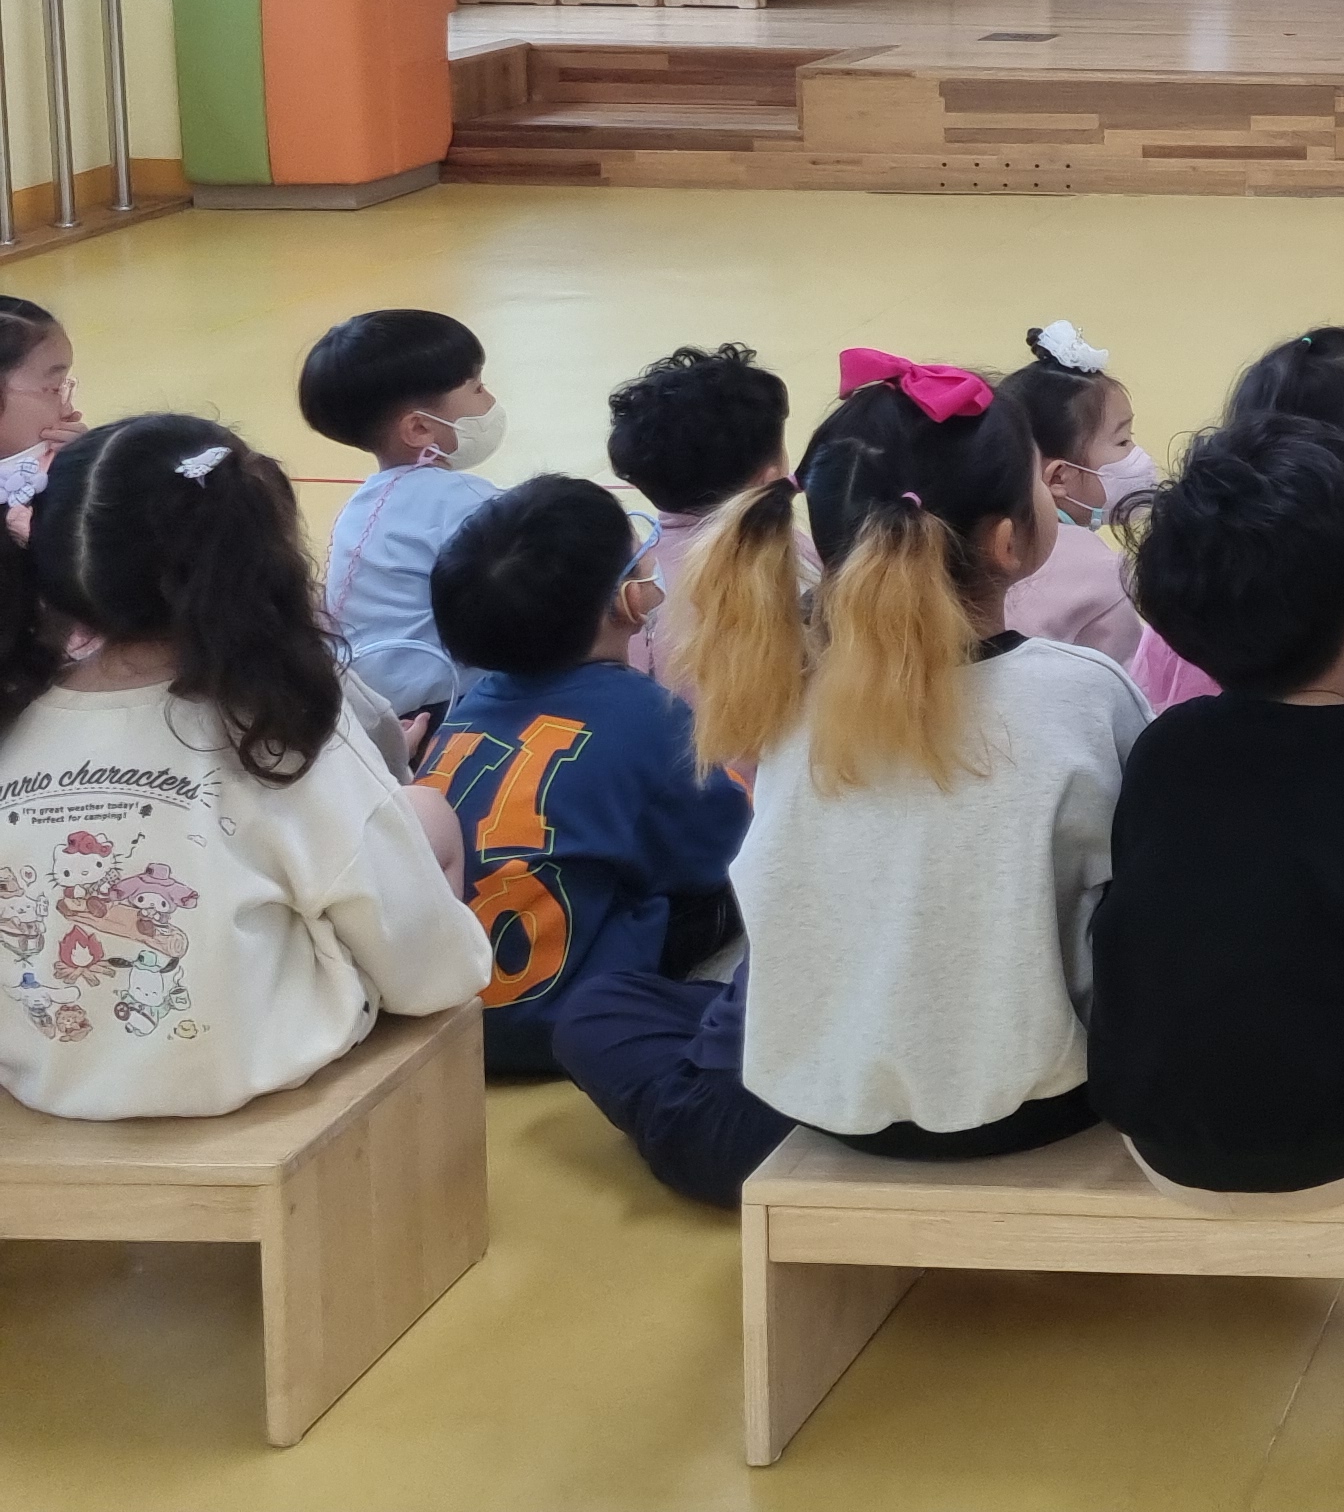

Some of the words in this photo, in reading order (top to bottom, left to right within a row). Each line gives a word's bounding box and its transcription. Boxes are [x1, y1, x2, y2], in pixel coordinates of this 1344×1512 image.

[0, 771, 53, 802] nrio
[58, 759, 202, 801] characters
[39, 806, 65, 817] great
[67, 804, 105, 813] weather
[107, 802, 139, 812] today!
[31, 814, 65, 825] Perfect
[68, 813, 82, 822] for
[84, 812, 127, 823] camping!
